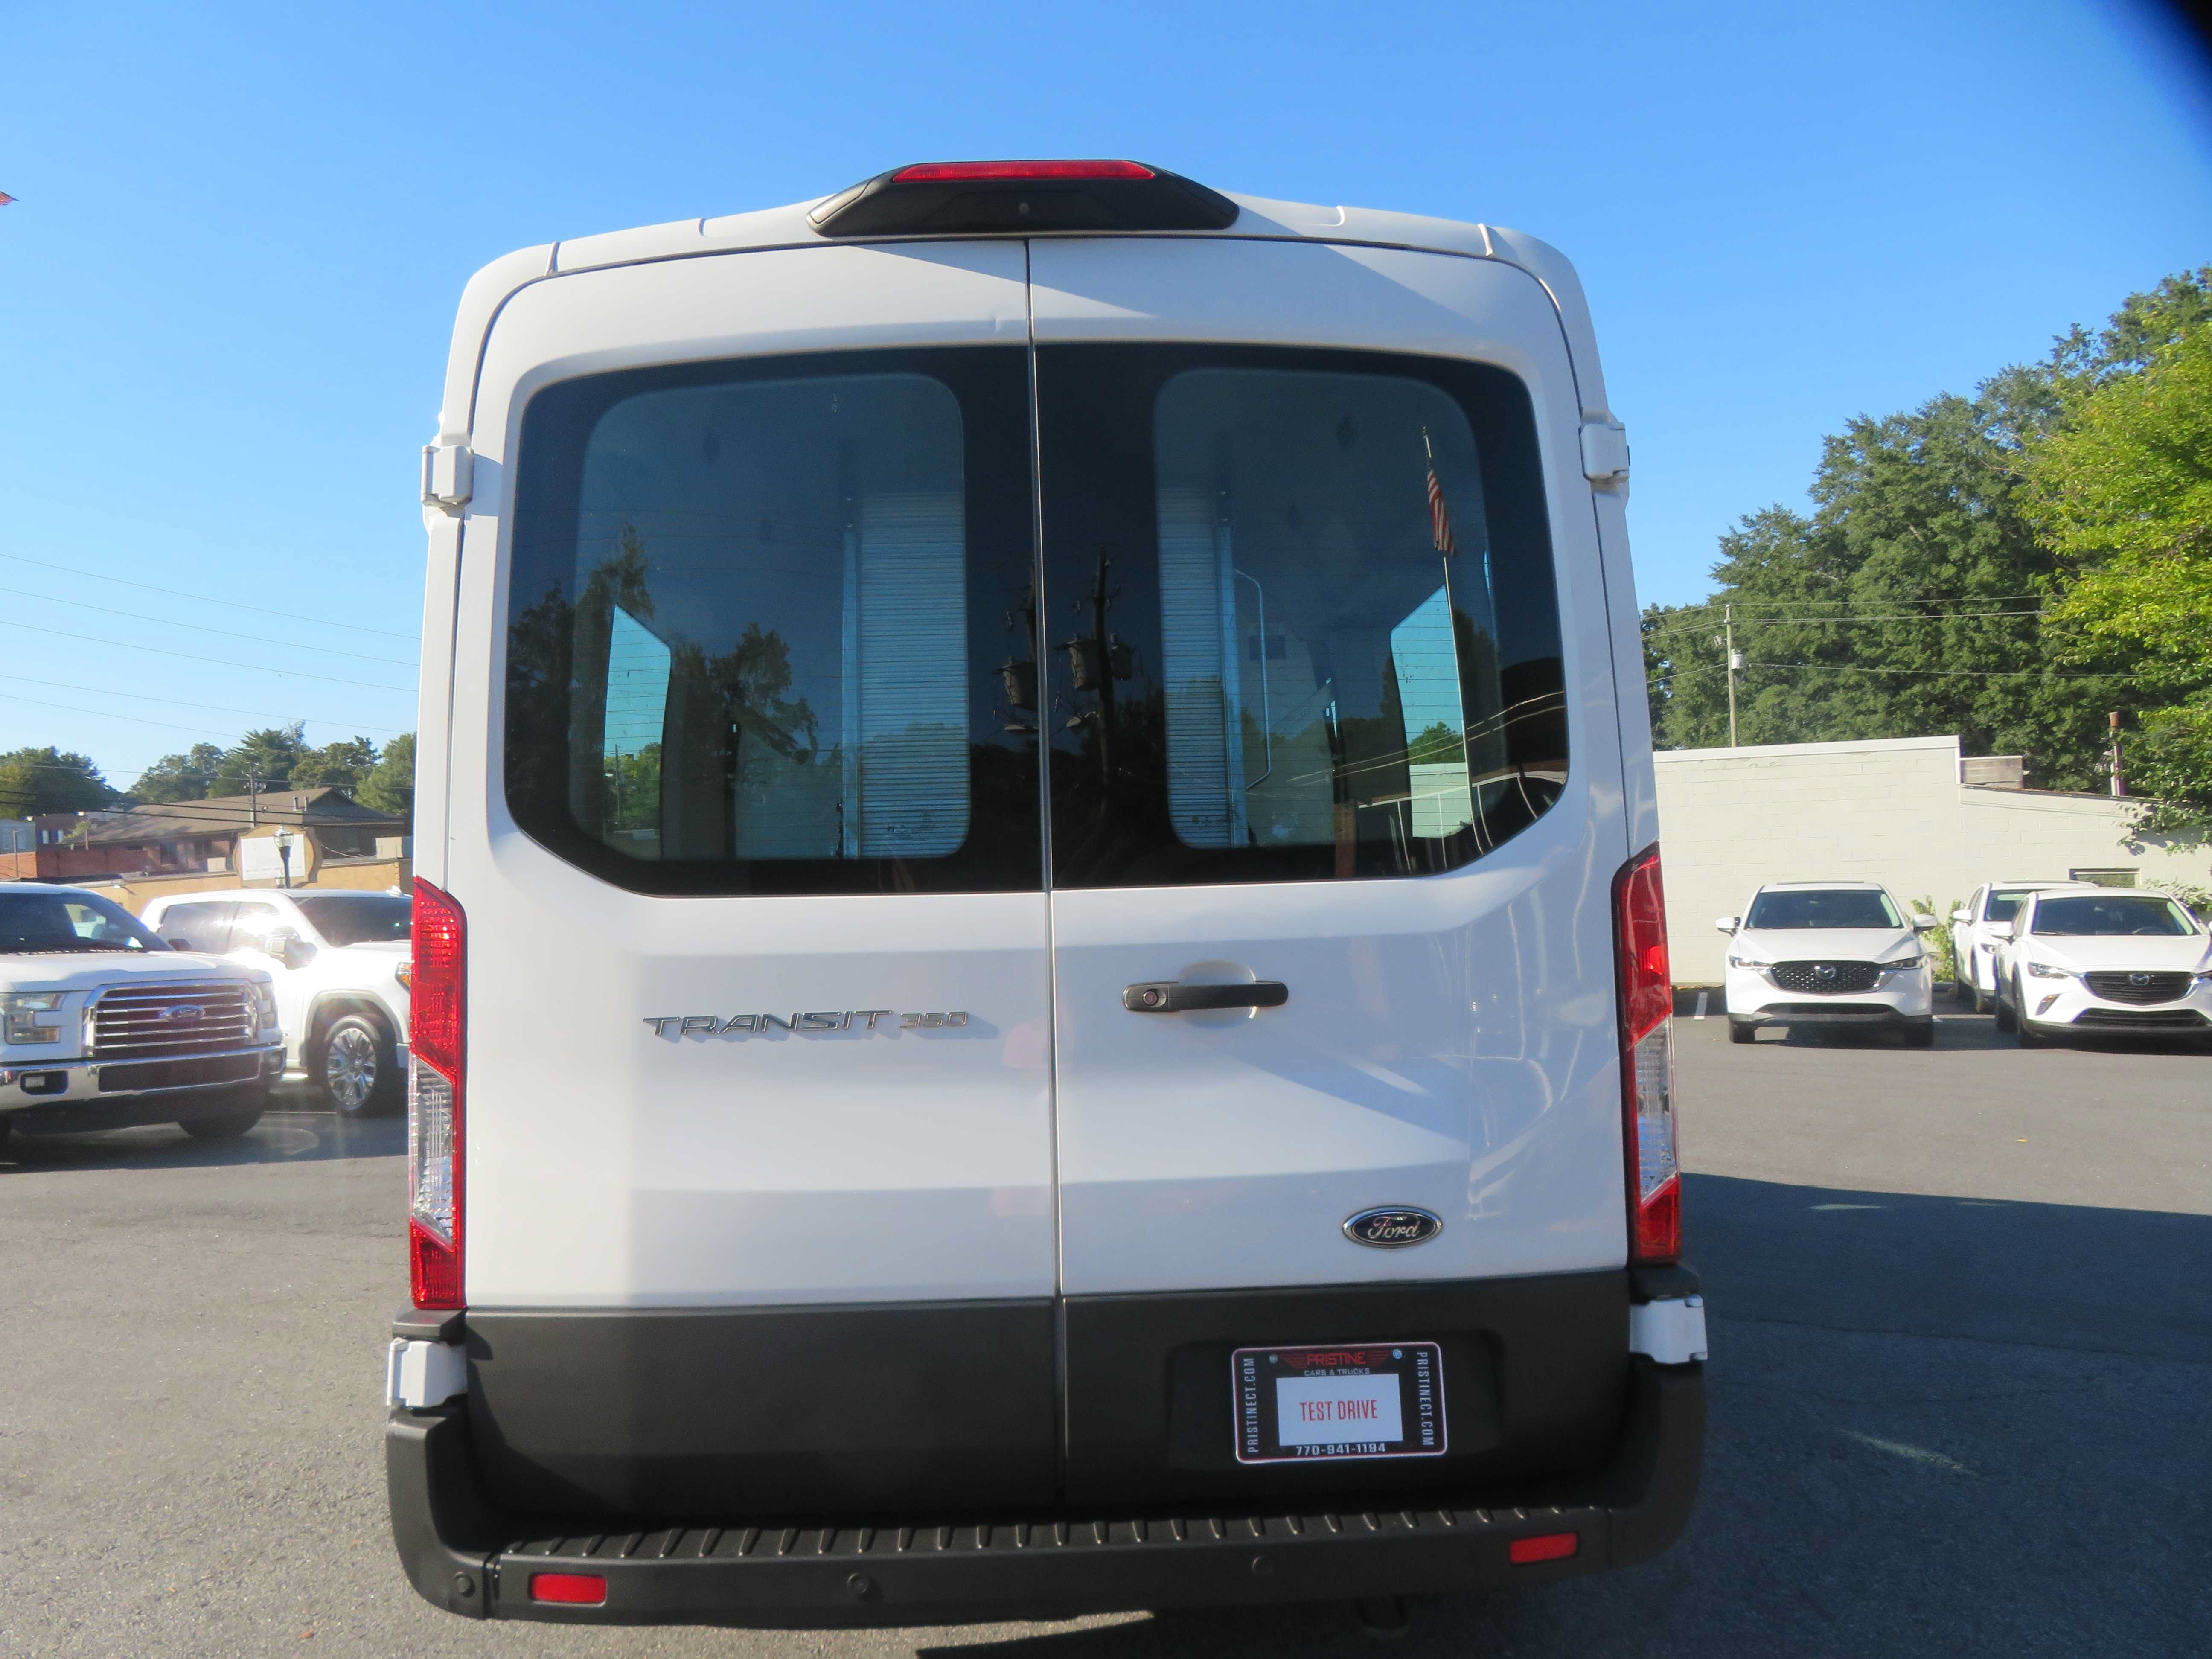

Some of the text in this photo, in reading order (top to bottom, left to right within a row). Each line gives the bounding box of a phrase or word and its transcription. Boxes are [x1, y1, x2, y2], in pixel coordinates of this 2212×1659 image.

[642, 1010, 968, 1036] TRANSIT 350
[1367, 1216, 1420, 1239] Ford
[1306, 1351, 1366, 1365] PRISTINE
[1243, 1357, 1259, 1453] PRISTINECT.COM
[1299, 1399, 1378, 1421] TEST DRIVE
[1417, 1352, 1435, 1446] PRISTINECT.COM
